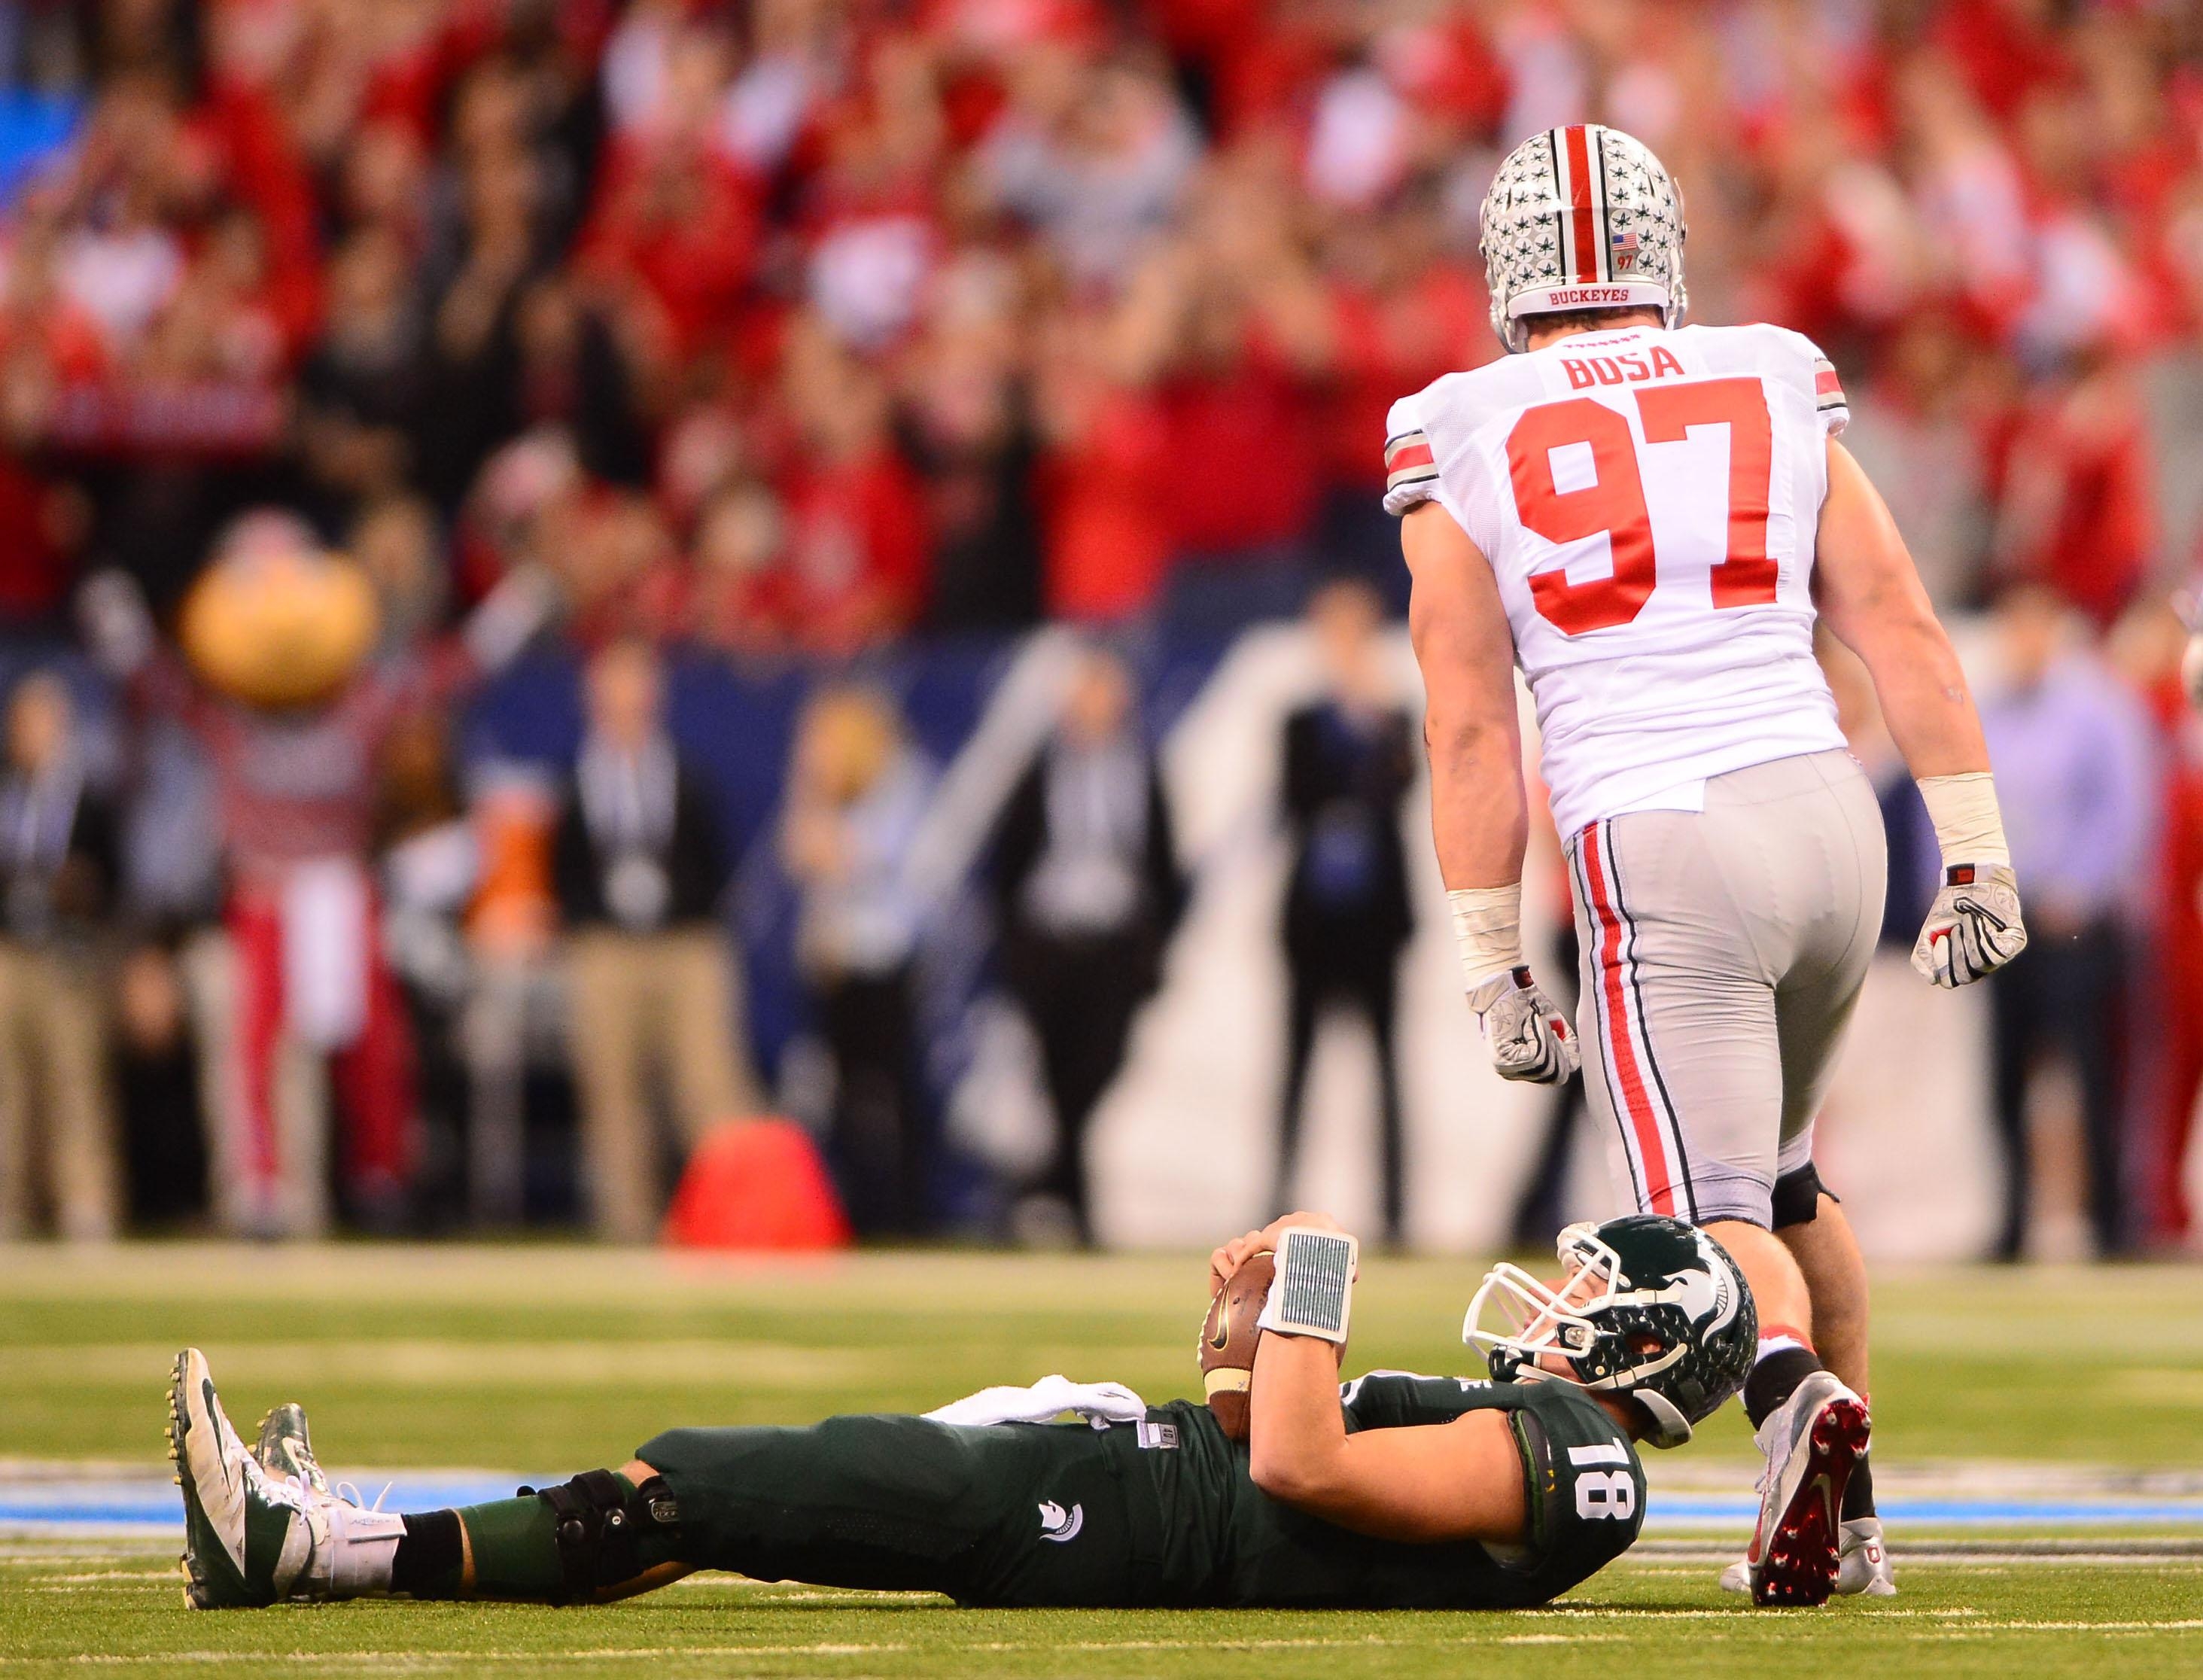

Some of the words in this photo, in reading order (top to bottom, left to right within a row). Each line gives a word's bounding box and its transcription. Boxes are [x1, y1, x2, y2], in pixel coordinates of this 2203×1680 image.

[1617, 255, 1633, 270] 97
[1549, 289, 1629, 305] BUCKEYES
[1560, 345, 1685, 389] BOSA
[1506, 377, 1778, 635] 97
[1567, 1437, 1635, 1520] 18
